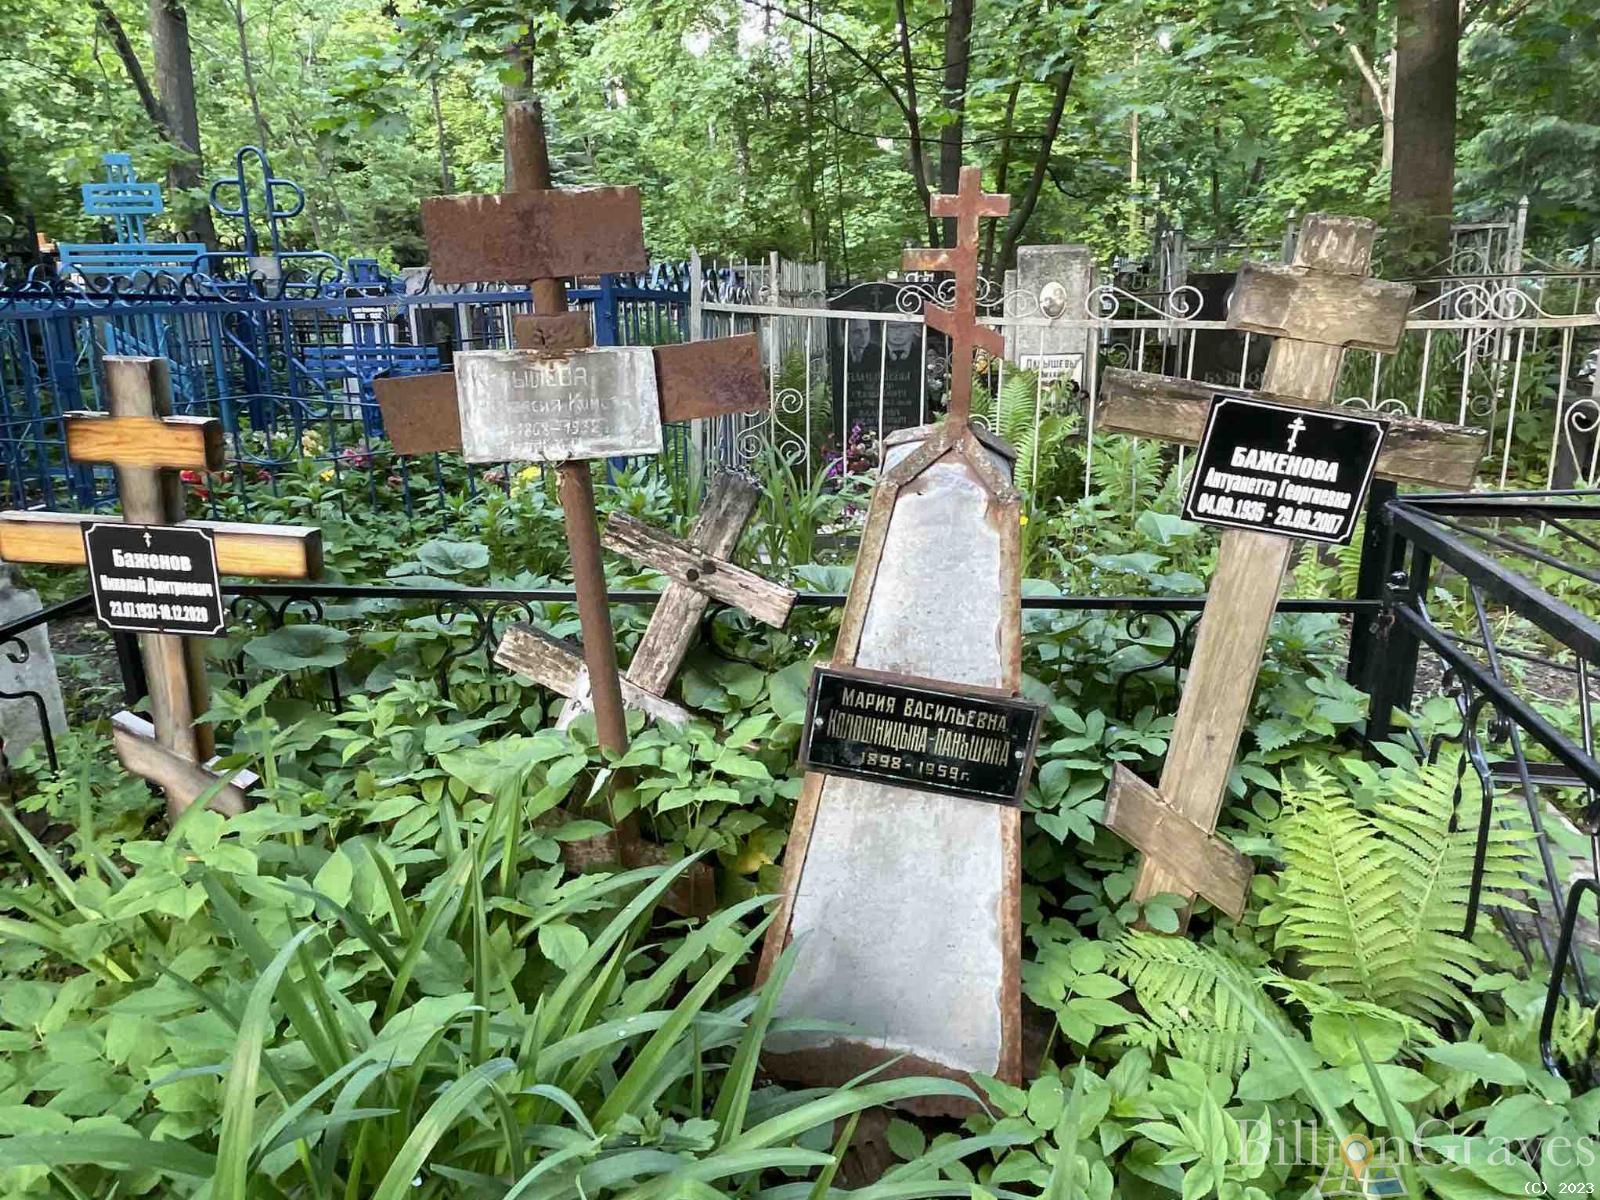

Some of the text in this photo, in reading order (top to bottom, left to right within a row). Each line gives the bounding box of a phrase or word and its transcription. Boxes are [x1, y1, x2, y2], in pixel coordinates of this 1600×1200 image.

[1230, 446, 1340, 483] БАЖЕНОВА
[1203, 467, 1352, 510] Антуанетта Георгиевна
[1197, 493, 1267, 522] 04.09.1935
[1274, 506, 1345, 534] 29.09.2007
[111, 548, 192, 572] Баженов
[147, 577, 214, 598] Дмитриевич
[841, 687, 1009, 732] МАРИЯ ВАСИЛЬЕВНА
[860, 751, 902, 769] 1898
